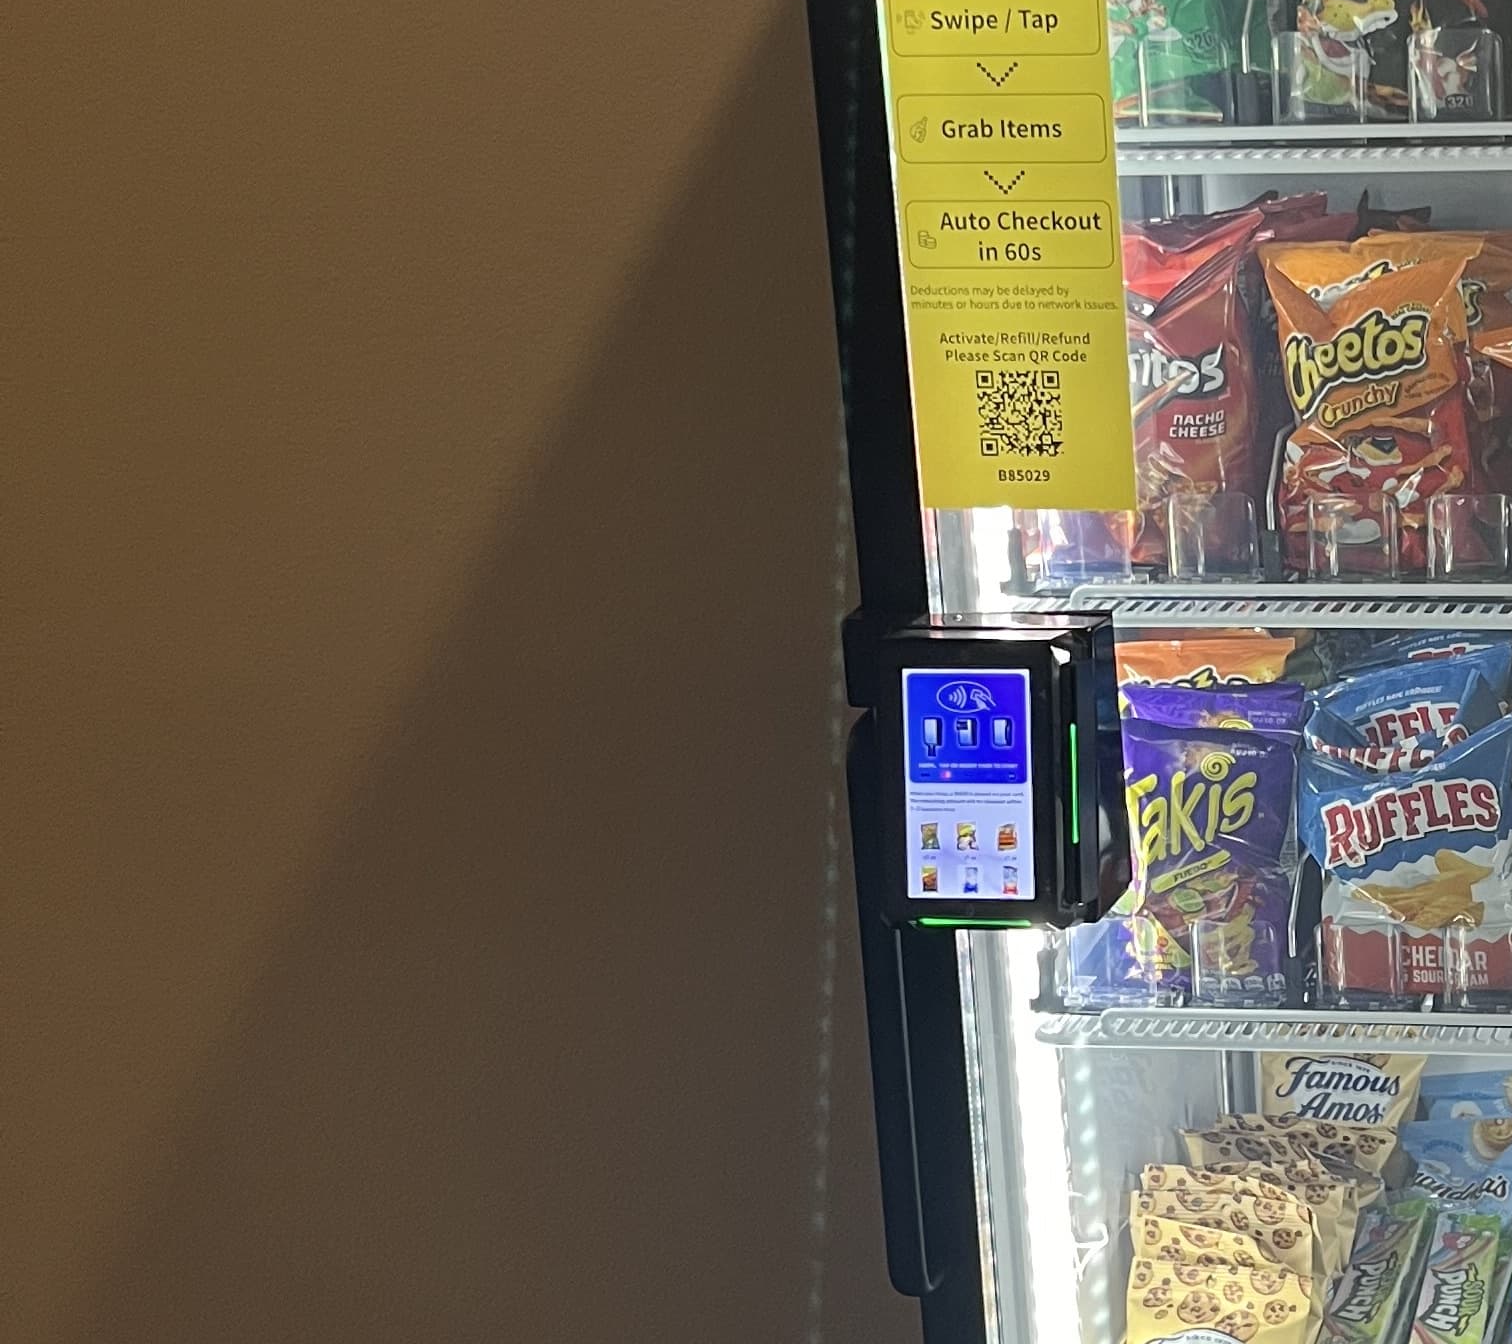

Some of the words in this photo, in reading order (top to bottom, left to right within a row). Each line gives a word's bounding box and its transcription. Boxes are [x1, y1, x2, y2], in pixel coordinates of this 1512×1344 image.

[930, 9, 998, 35] Swipe
[1004, 8, 1012, 33] /
[1018, 9, 1058, 34] Tap
[942, 118, 994, 138] Grab
[1000, 119, 1062, 138] Items
[940, 211, 991, 231] Auto
[997, 211, 1102, 231] Checkout
[978, 241, 998, 261] in
[1005, 242, 1042, 261] 60s
[910, 285, 970, 297] Deductions
[972, 287, 994, 298] may
[996, 285, 1011, 297] be
[1012, 285, 1054, 299] delayed
[1056, 285, 1069, 298] by
[911, 299, 955, 311] minutes
[957, 301, 967, 311] or
[969, 299, 999, 311] hours
[1002, 299, 1022, 311] due
[1024, 300, 1035, 311] to
[1038, 299, 1082, 311] network
[940, 332, 1091, 346] Activate/Refill/Refund
[945, 350, 989, 363] Please
[993, 350, 1026, 363] Scan
[1029, 350, 1049, 364] QR
[1052, 350, 1088, 363] Code
[1285, 312, 1427, 412] Cheetos
[1318, 381, 1402, 428] Crunchy
[1172, 409, 1225, 426] NACHO
[1169, 422, 1225, 438] CHEESE
[998, 469, 1051, 483] B85029
[1126, 753, 1257, 869] Takis
[1324, 783, 1500, 867] RUFFLES
[1413, 969, 1444, 984] SOUR
[1276, 1057, 1400, 1097] Famous
[1297, 1090, 1385, 1122] Amos
[1338, 1262, 1387, 1321] PUNCH
[1424, 1271, 1467, 1331] PUNCH
[1460, 1280, 1484, 1317] SOUR
